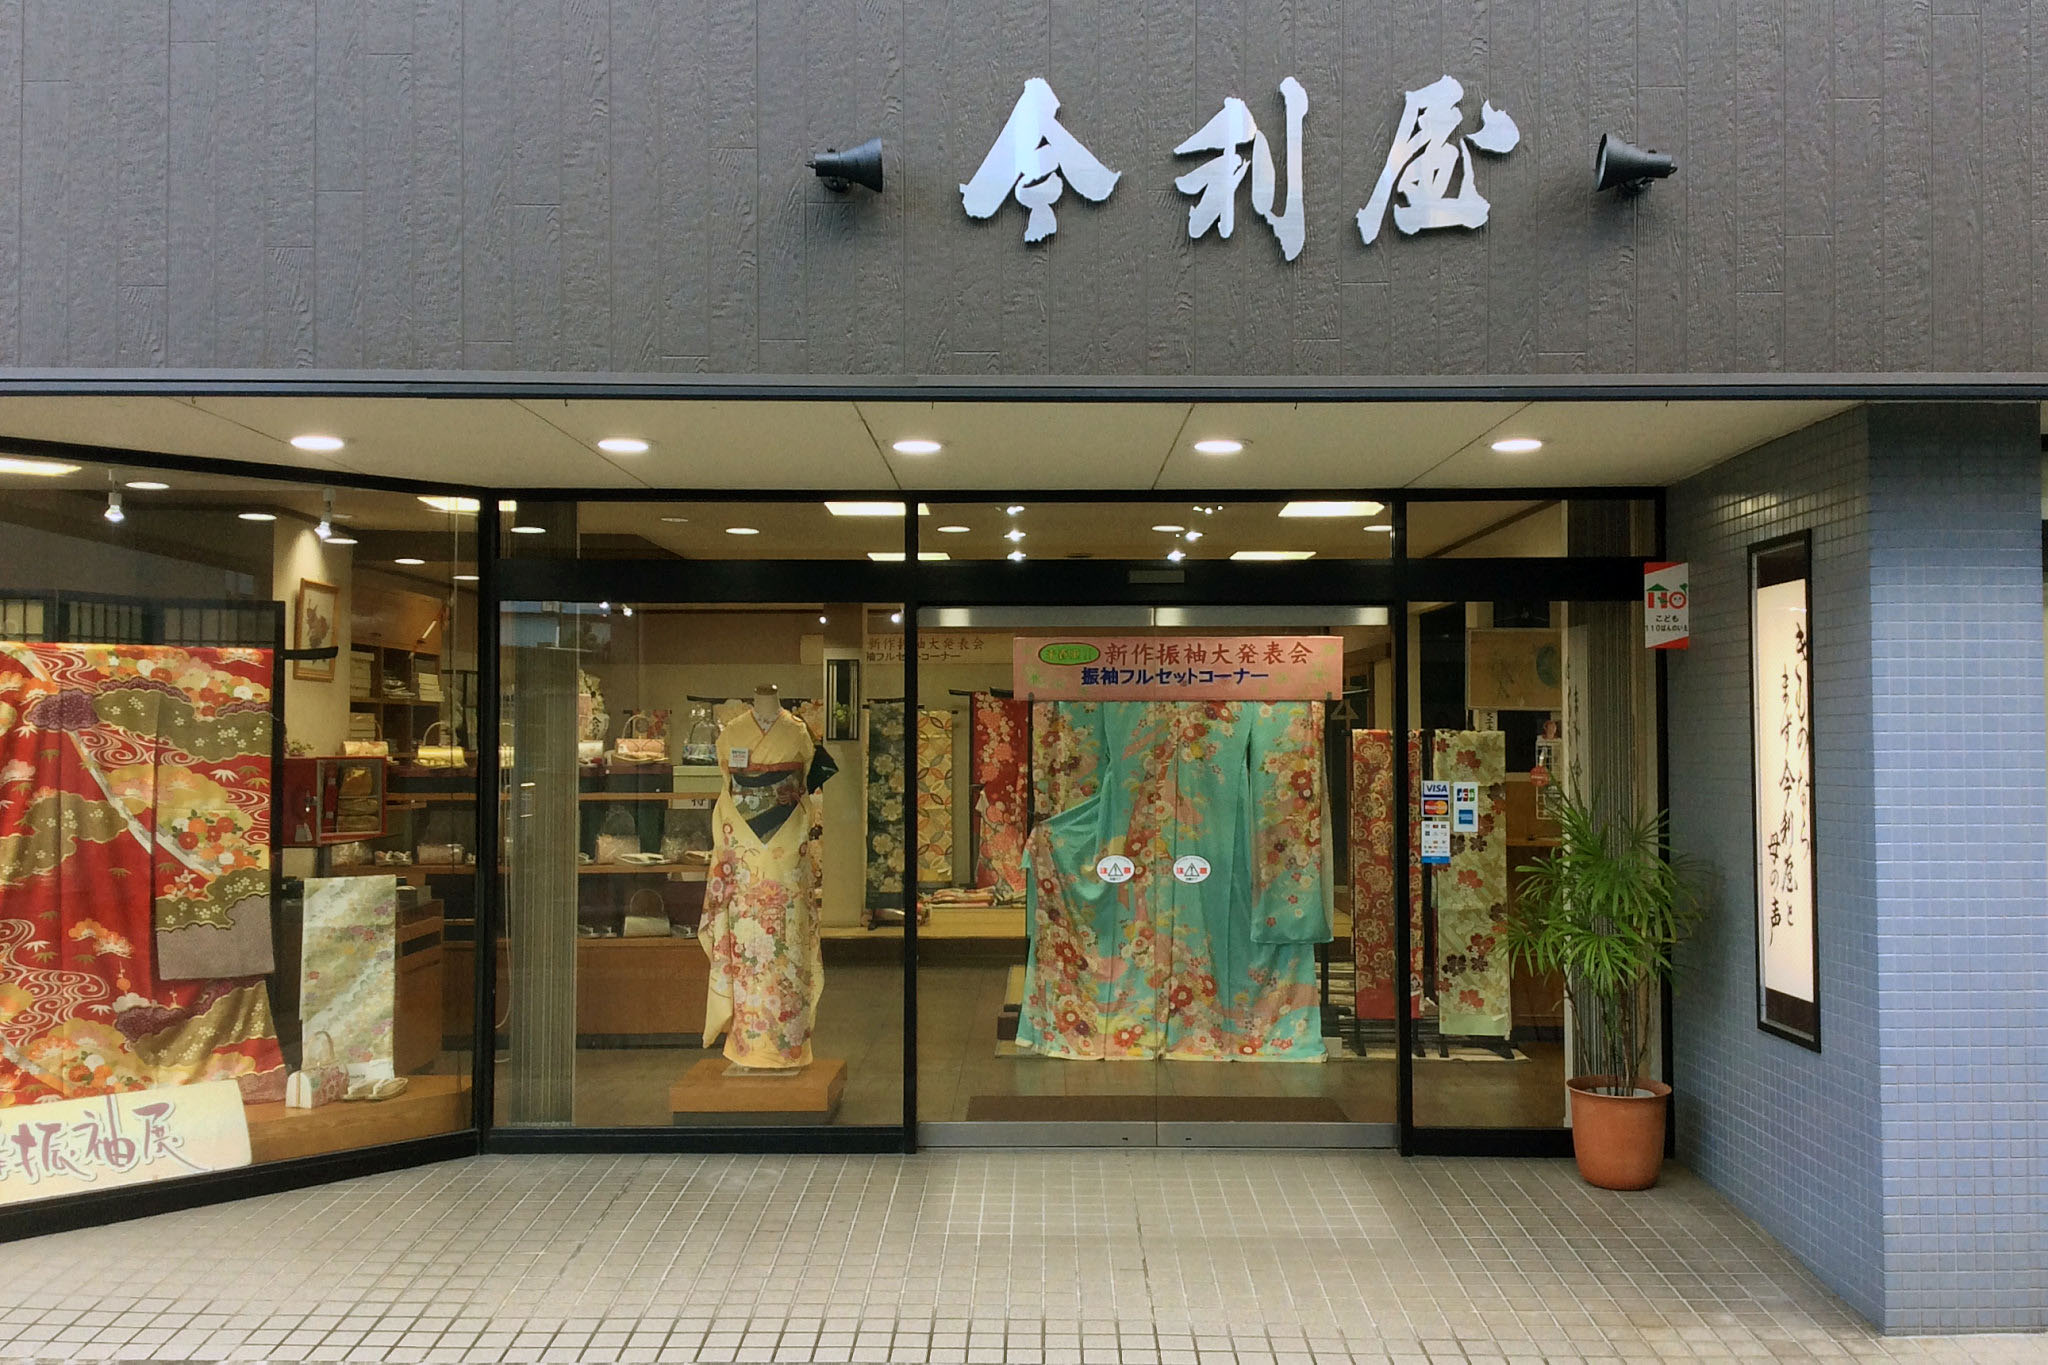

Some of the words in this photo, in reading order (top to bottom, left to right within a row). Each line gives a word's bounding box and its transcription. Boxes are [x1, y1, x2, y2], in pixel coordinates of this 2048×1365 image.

[960, 75, 1520, 262] 今利屋
[1105, 641, 1314, 666] 新作振袖大発表会
[1081, 666, 1270, 686] 振袖フルセットコーナー
[1426, 784, 1448, 793] VISA
[1456, 788, 1476, 802] JCB
[1767, 832, 1783, 947] 母の声
[0, 1094, 208, 1180] 振袖展
